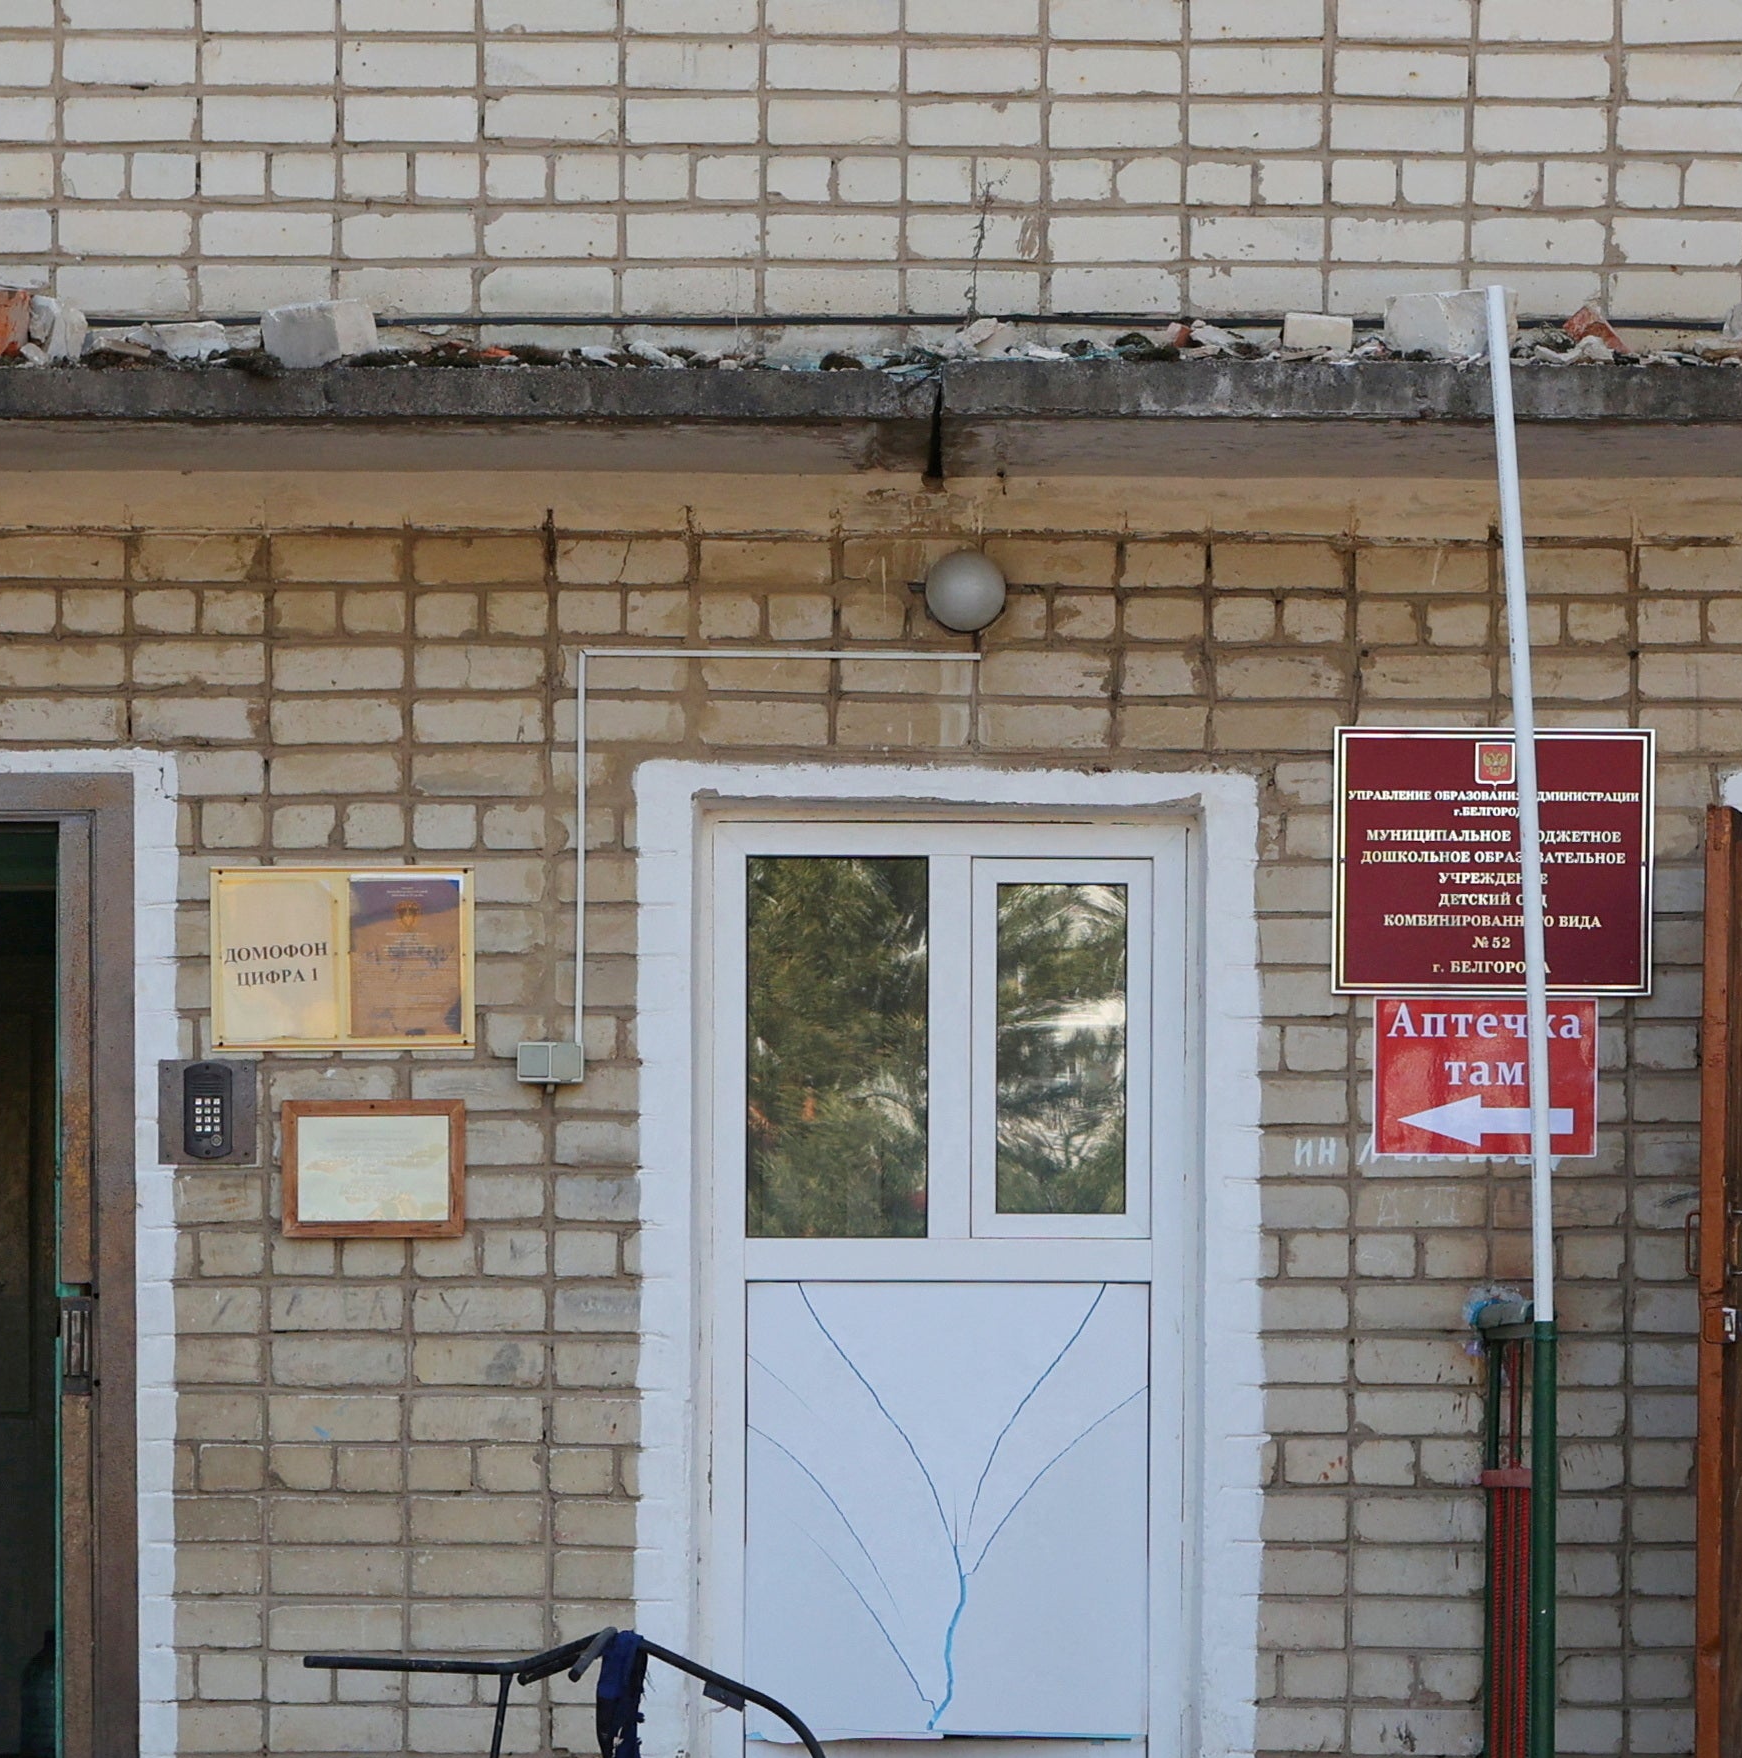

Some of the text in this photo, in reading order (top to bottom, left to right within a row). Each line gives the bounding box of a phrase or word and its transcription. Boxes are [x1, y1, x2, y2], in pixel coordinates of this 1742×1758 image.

[1348, 790, 1432, 801] УПРАВЛЕНИЕ
[1536, 791, 1639, 803] ДМИНИСТРАЦИИ
[1366, 829, 1622, 844] МУНИЦИПАЛЬНОЕ ДЖЕТНОЕ
[1360, 850, 1626, 865] ДОШКОЛЬНОЕ ОБРАЗВАТЕЛЬНОЕ
[1438, 872, 1548, 886] УЧРЕЖДЕНЕ
[1438, 892, 1511, 908] ДЕТСКИЙ
[1383, 914, 1602, 930] КОМБИНИРОВАННО ВИДА
[1472, 936, 1511, 949] № 52
[224, 940, 329, 965] ДОМОФОН
[1432, 960, 1551, 974] г. БЕЛГОРОА
[237, 969, 306, 988] ЦИФРА
[1444, 1059, 1526, 1086] там
